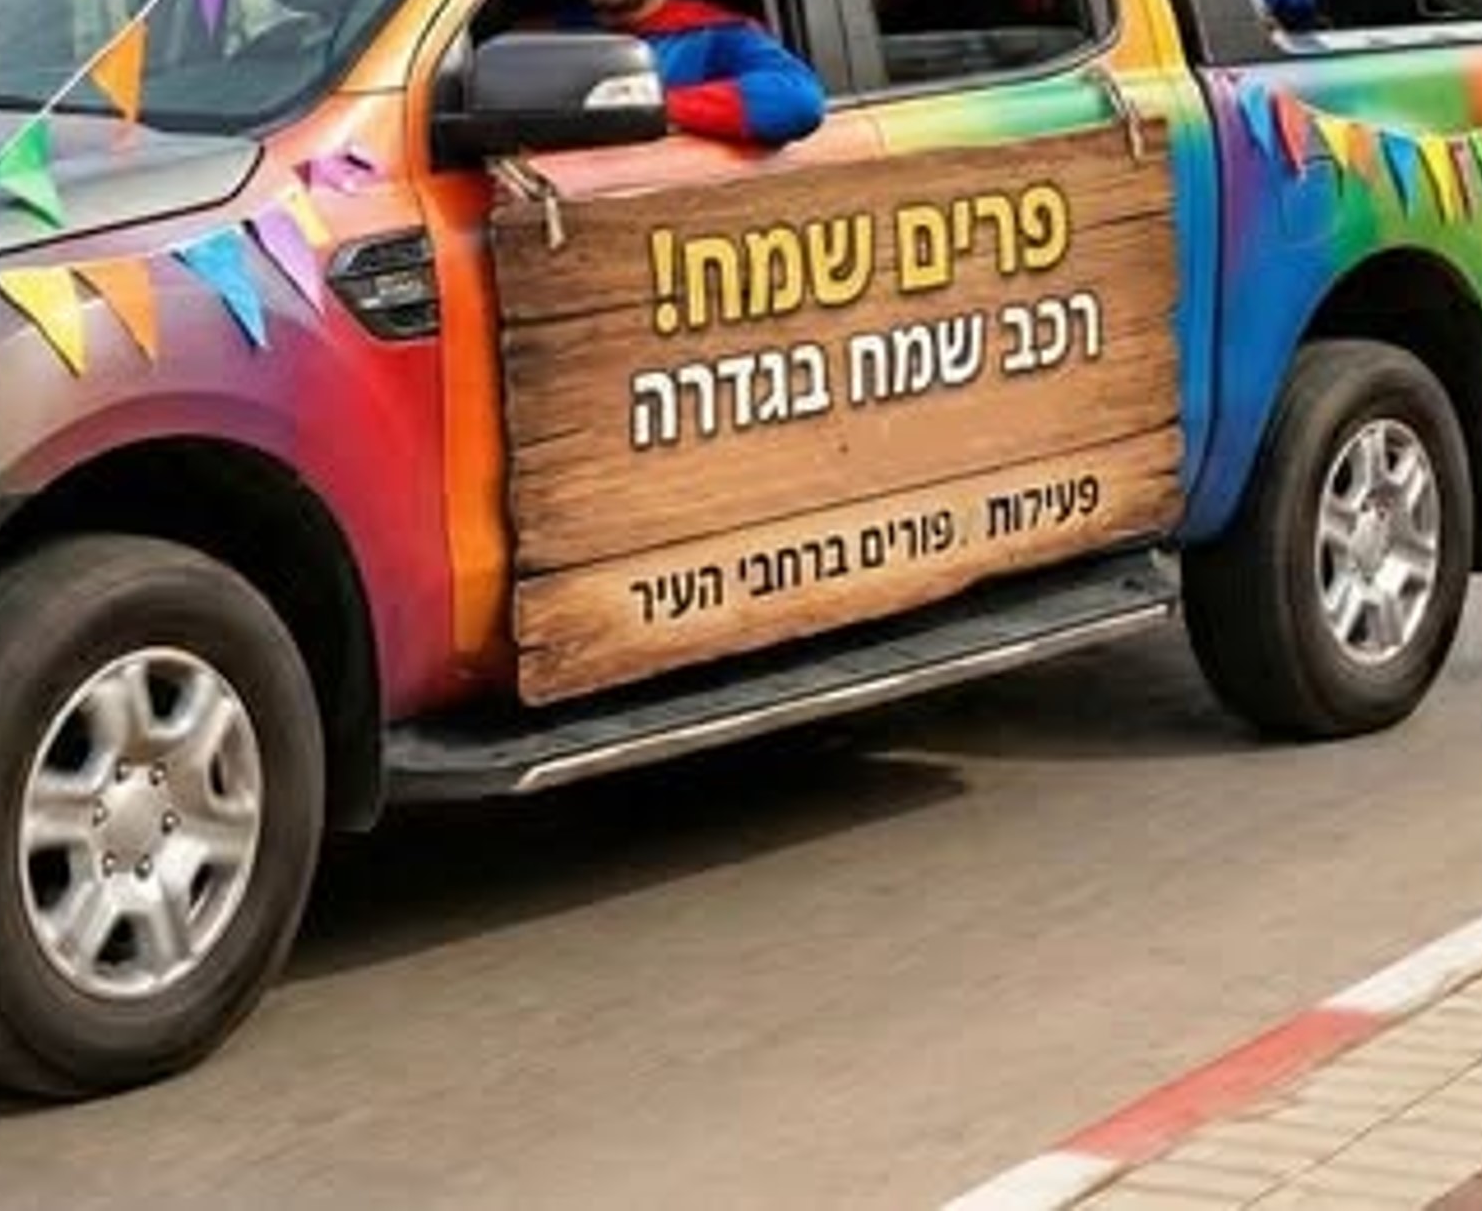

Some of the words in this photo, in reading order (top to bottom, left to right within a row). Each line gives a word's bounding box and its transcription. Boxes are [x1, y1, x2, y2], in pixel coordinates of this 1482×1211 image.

[651, 213, 873, 333] שמח!
[895, 184, 1070, 292] פרים
[848, 312, 985, 405] שמח
[1002, 292, 1101, 372] רכב
[631, 343, 831, 447] בגדרה
[738, 535, 850, 596] ברחבי
[860, 510, 954, 570] פורים
[630, 566, 724, 623] העיר
